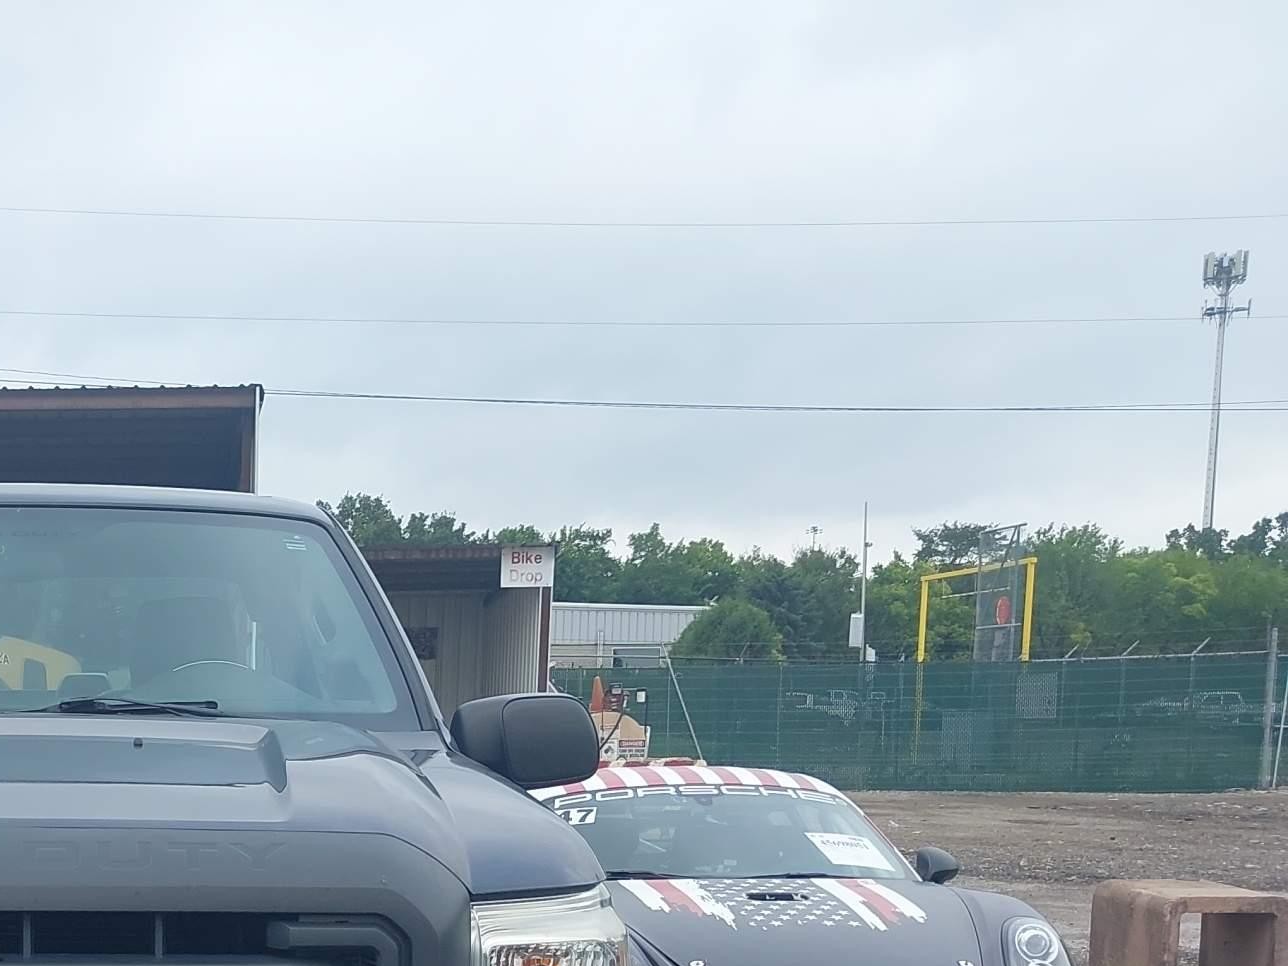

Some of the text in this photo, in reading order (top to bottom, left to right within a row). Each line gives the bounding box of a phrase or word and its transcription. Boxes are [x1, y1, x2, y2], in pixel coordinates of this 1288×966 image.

[511, 551, 542, 565] Bike
[509, 569, 542, 584] Drop
[553, 784, 837, 809] PORSCHE
[20, 840, 289, 872] DUTY
